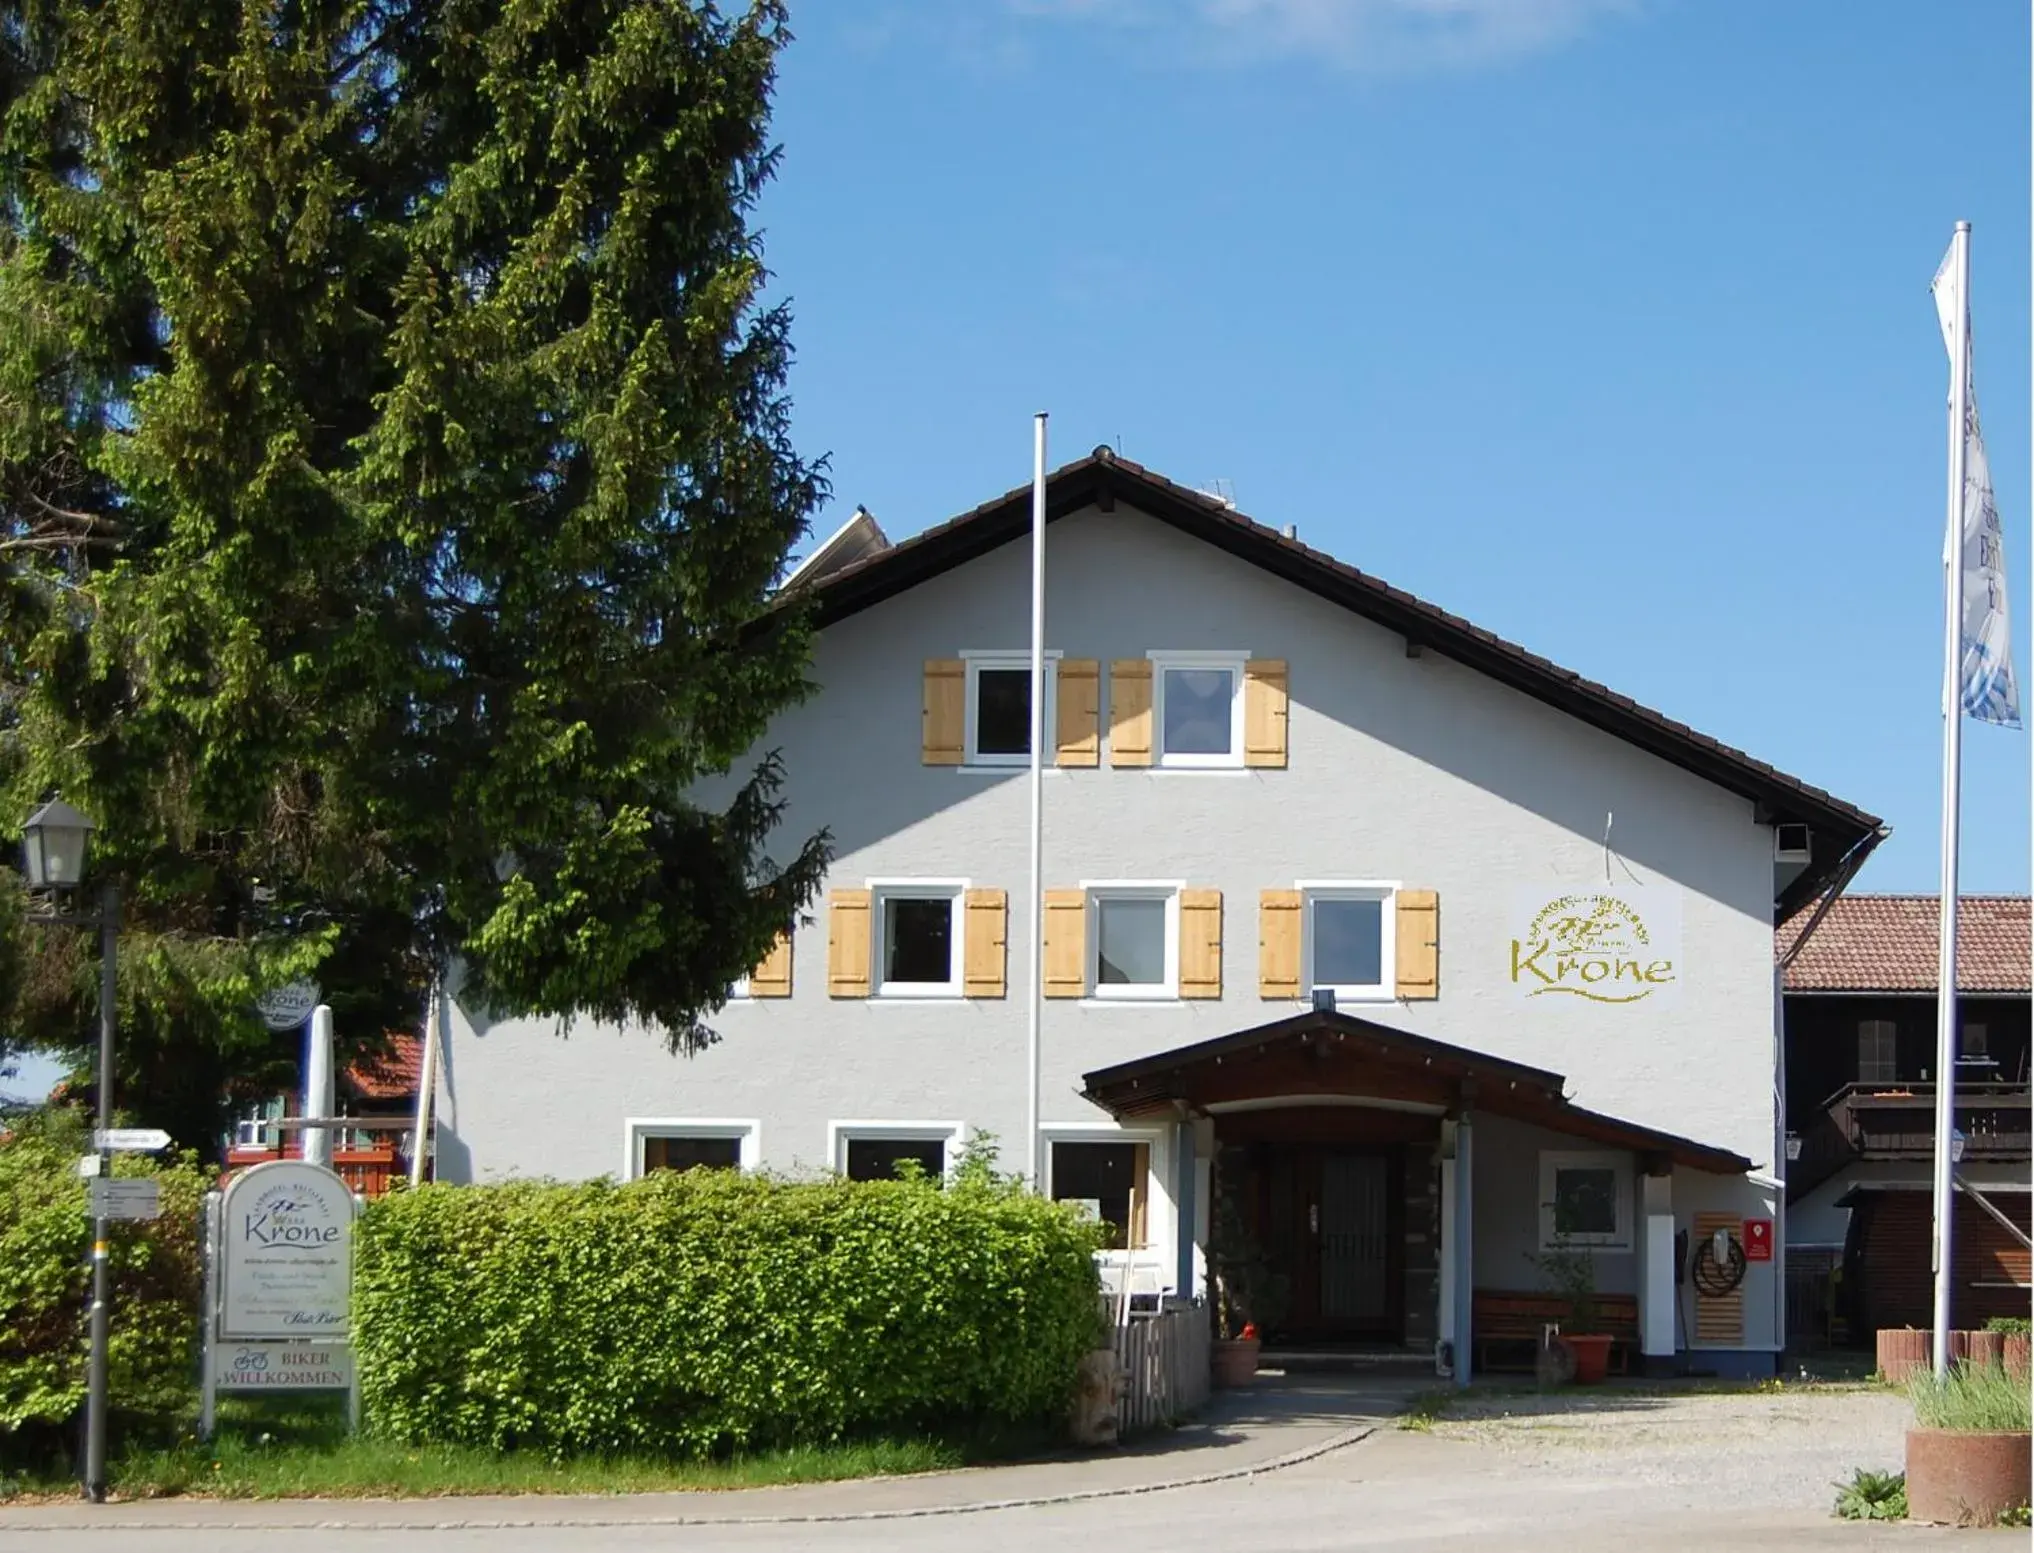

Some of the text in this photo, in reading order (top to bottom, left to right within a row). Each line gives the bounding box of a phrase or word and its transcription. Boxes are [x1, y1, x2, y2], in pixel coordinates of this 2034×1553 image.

[1511, 938, 1676, 984] Krone
[246, 1213, 341, 1243] Krone
[281, 1352, 330, 1365] BIKER
[224, 1371, 343, 1384] WILLKOMMEN
